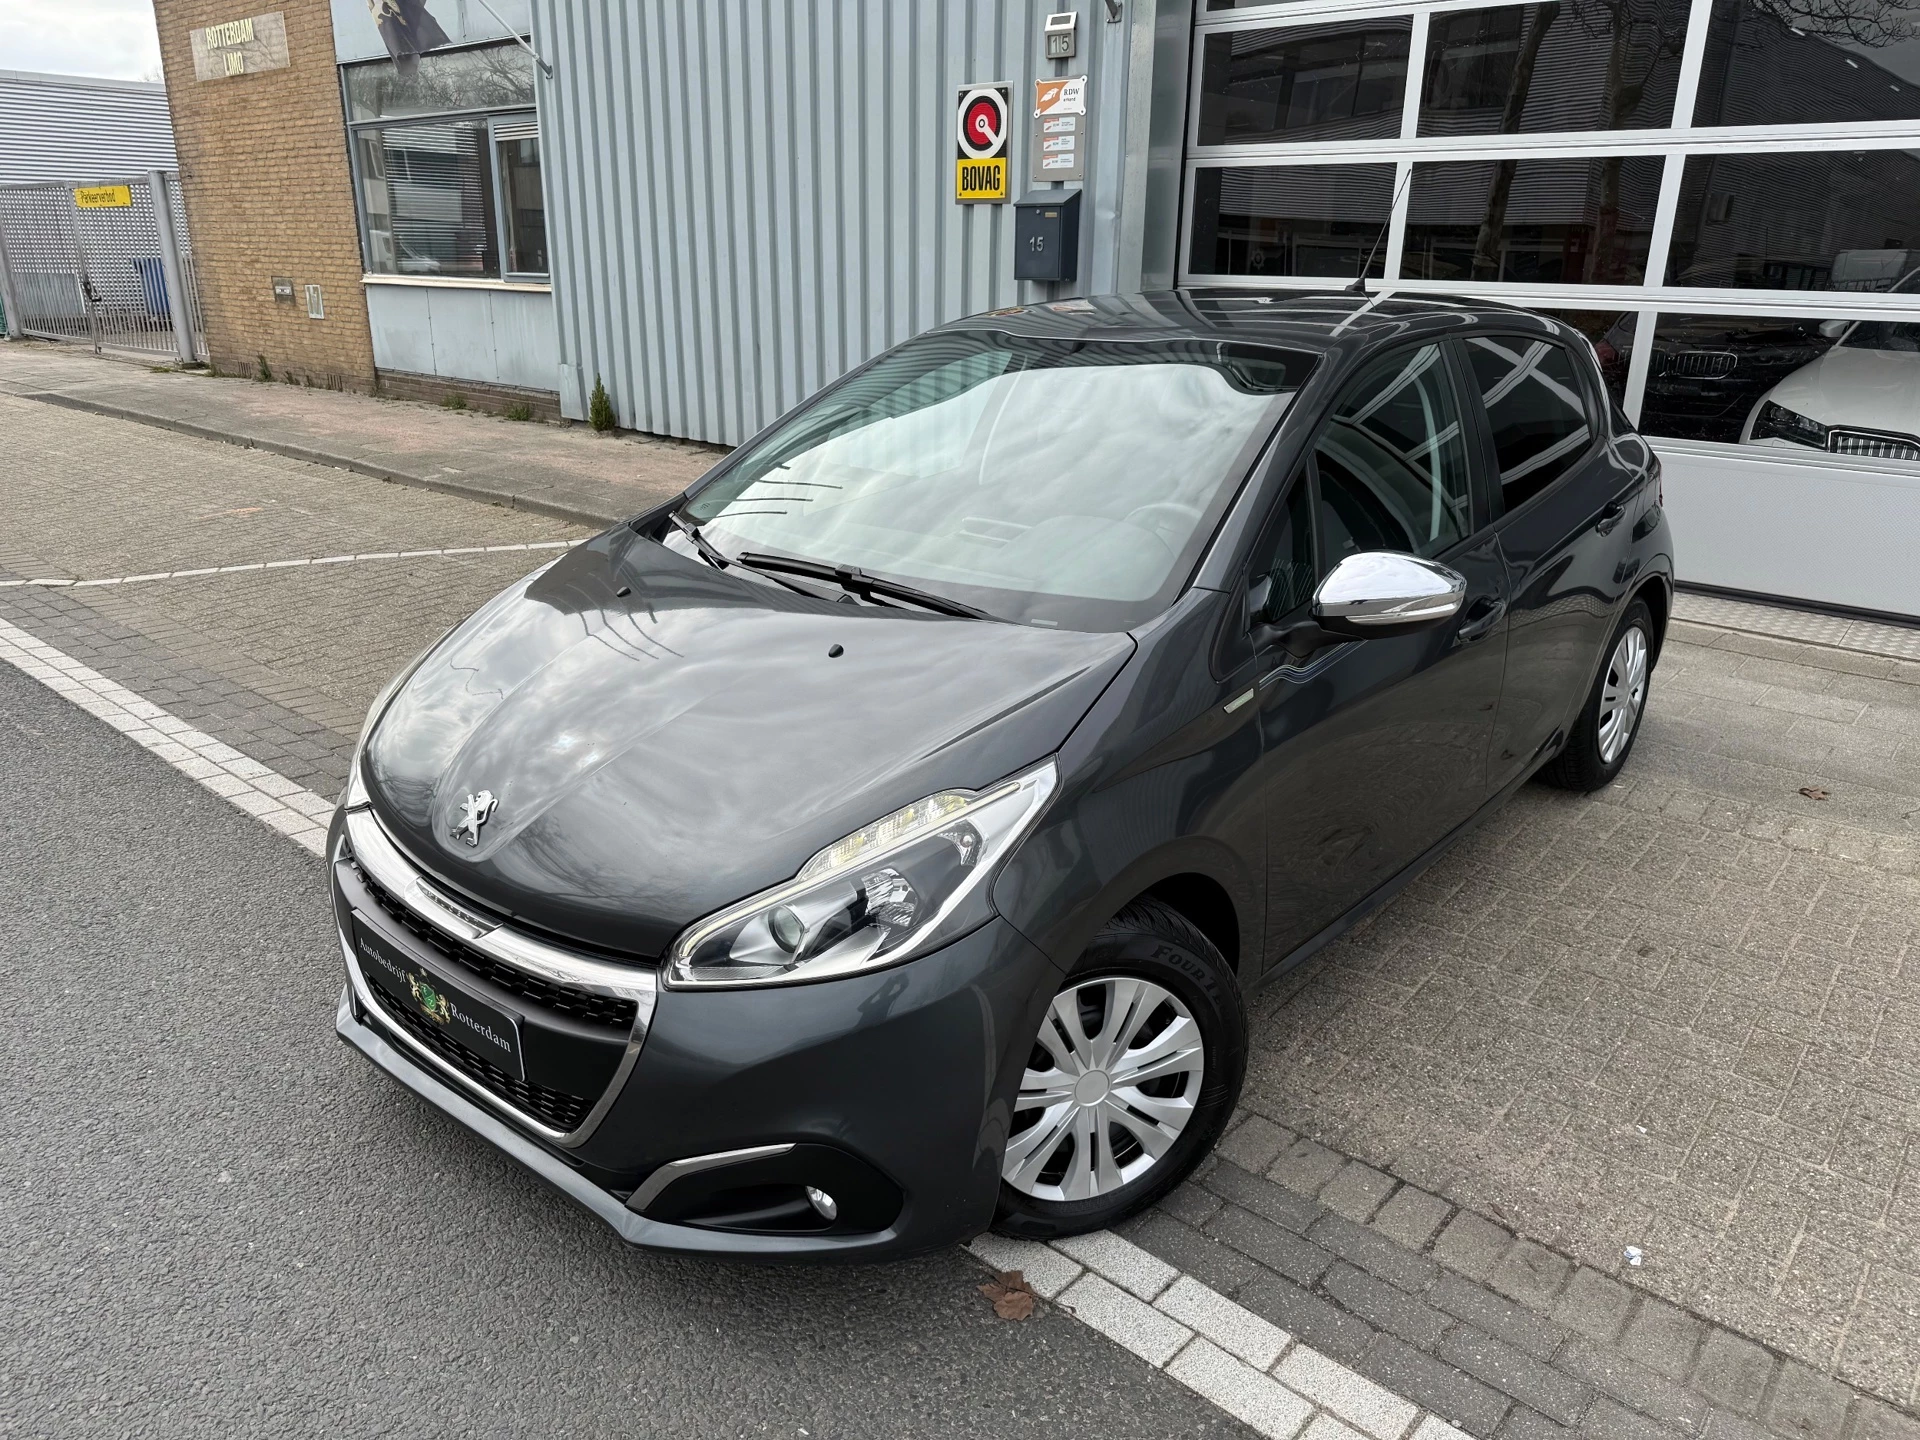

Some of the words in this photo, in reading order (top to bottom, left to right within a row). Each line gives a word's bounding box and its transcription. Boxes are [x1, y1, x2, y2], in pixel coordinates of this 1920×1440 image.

[205, 17, 254, 50] ROTTERDAM
[1052, 35, 1069, 52] 15
[222, 51, 244, 76] LIMO
[1063, 88, 1080, 96] RDW
[961, 165, 1001, 191] BOVAG
[1029, 236, 1044, 252] 15
[359, 936, 407, 983] Autobedrijf
[450, 1002, 512, 1053] Rotterdam
